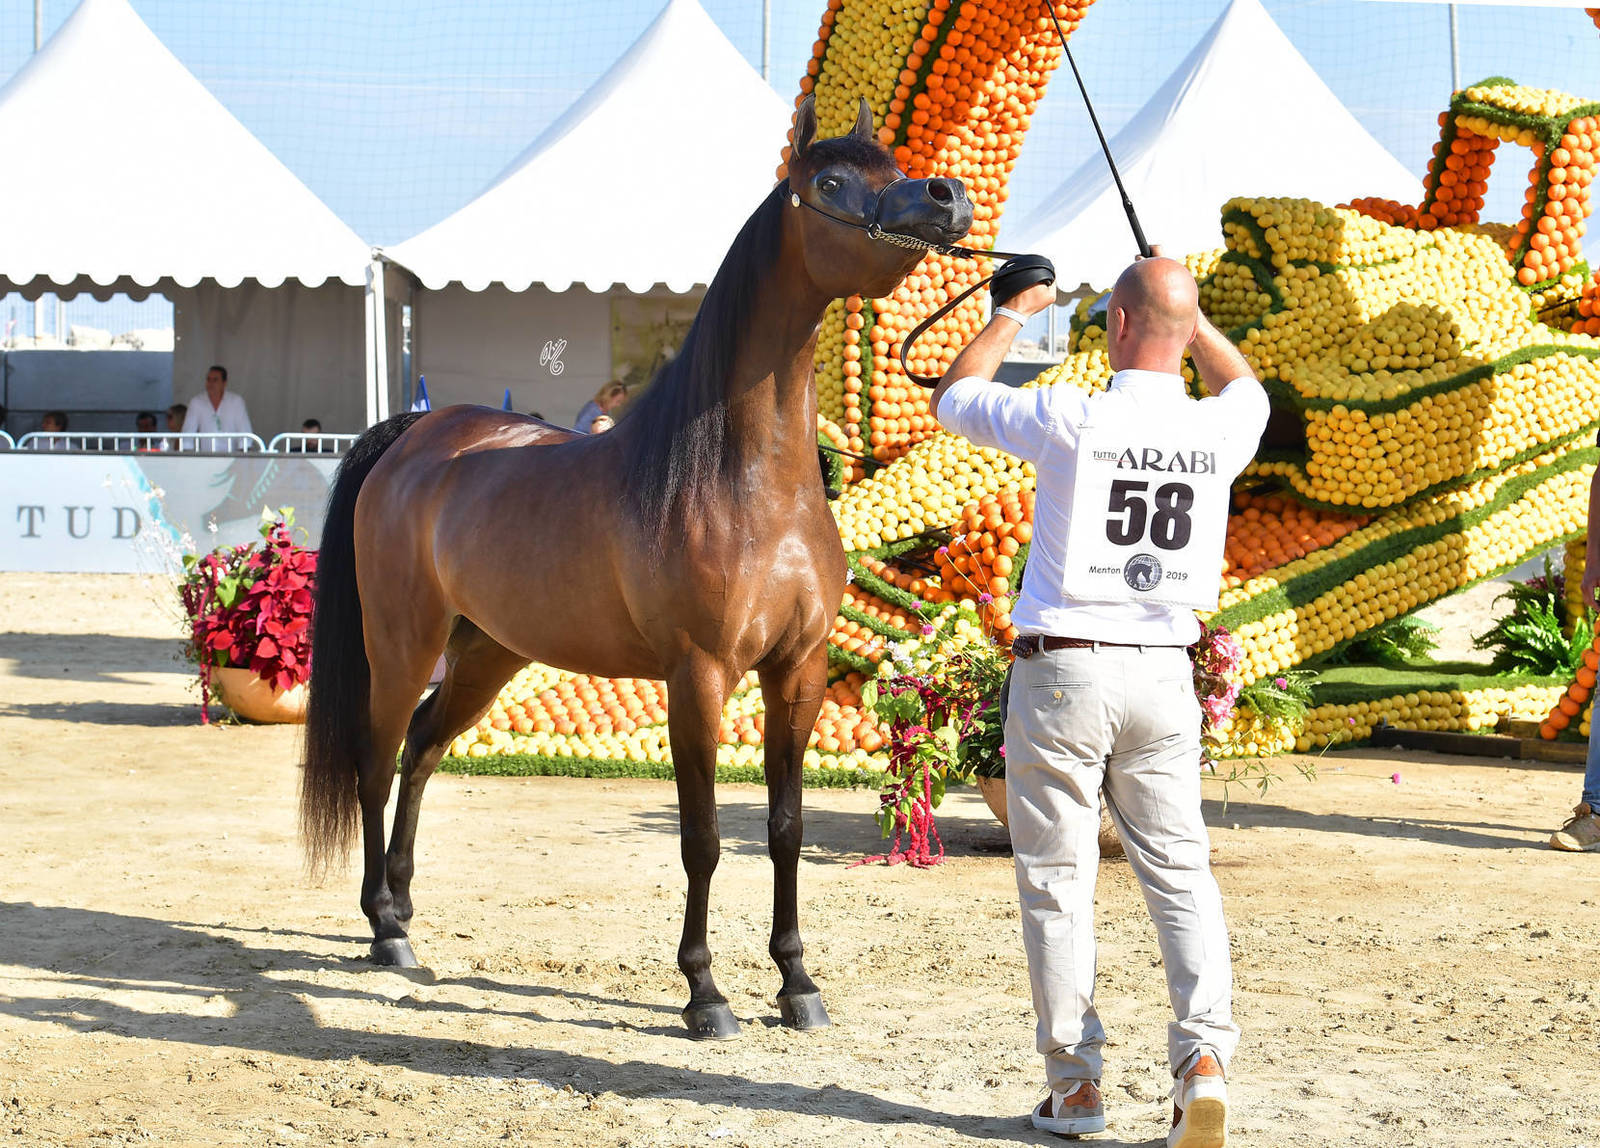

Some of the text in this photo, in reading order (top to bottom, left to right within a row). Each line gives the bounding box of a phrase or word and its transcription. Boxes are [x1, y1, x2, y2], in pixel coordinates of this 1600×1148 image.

[1092, 447, 1216, 475] TUTTO ARABI
[1105, 479, 1195, 551] 58
[1089, 565, 1189, 581] Menton 2019
